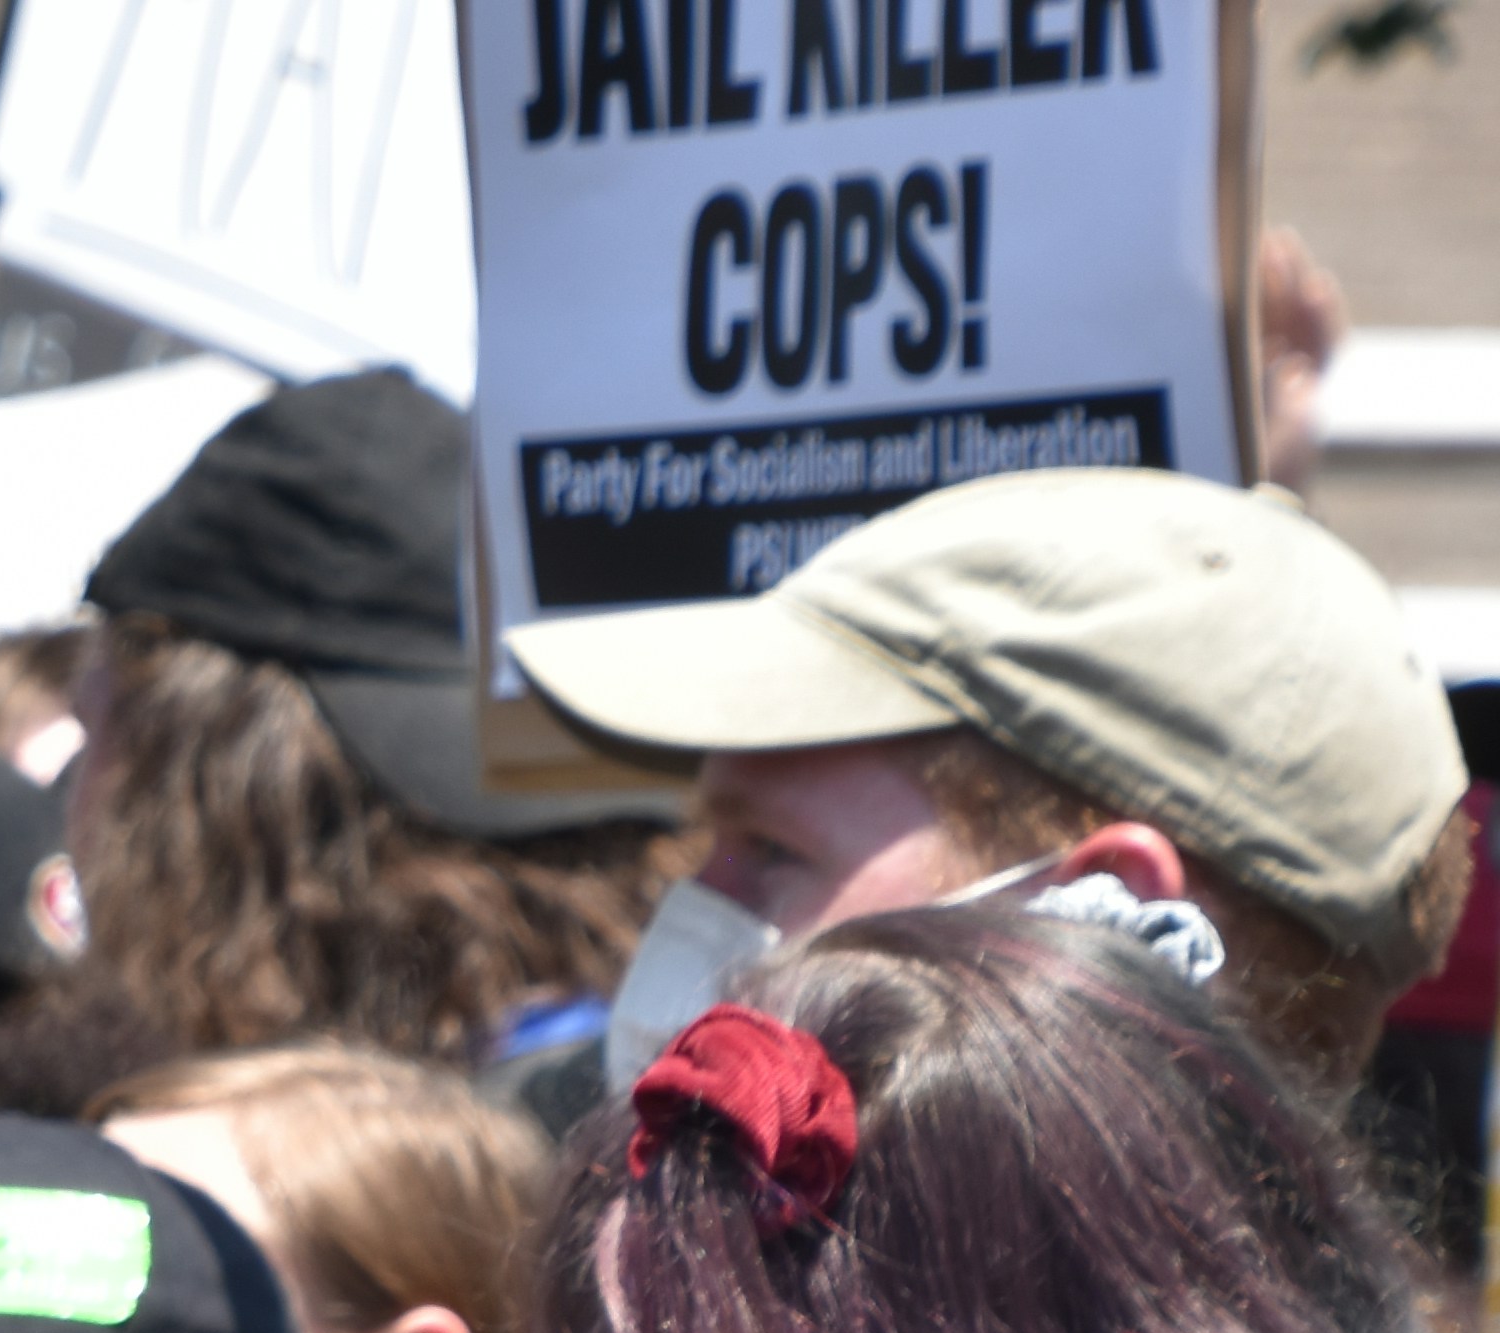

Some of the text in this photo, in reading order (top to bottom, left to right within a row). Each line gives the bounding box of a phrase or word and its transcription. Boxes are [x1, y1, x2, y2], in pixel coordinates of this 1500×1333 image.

[684, 159, 991, 398] COPS!
[541, 404, 1139, 526] Party For Socialism and Liberation
